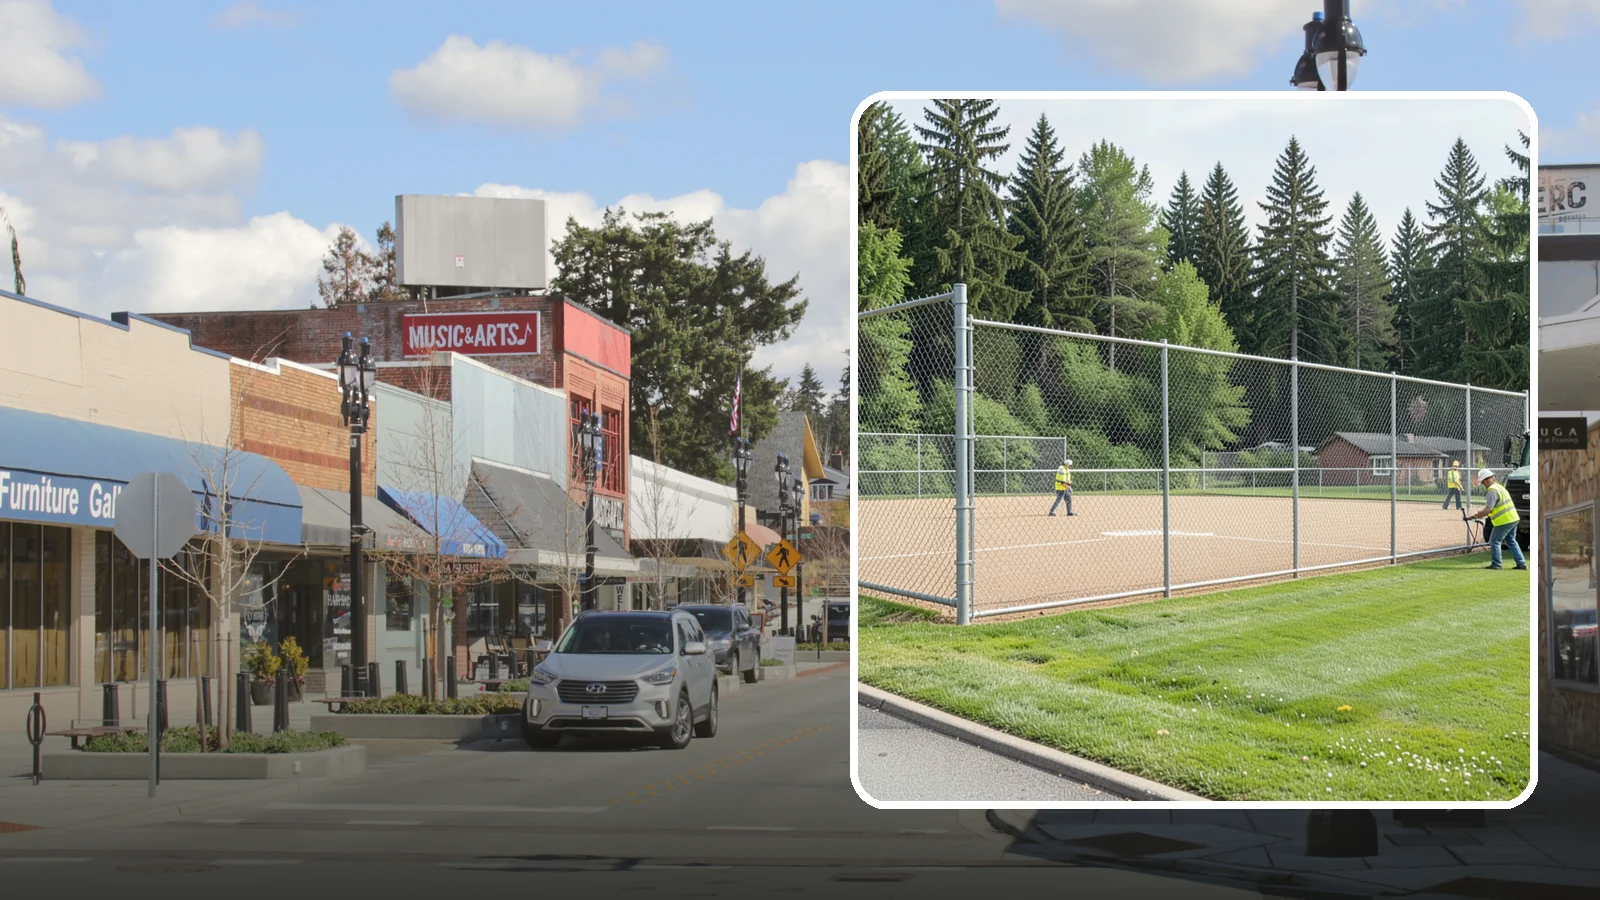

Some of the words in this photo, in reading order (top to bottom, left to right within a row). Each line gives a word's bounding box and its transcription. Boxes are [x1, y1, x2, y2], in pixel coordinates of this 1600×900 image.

[409, 323, 519, 348] MUSIC&ARTS
[1540, 427, 1577, 437] UGA
[0, 471, 79, 515] Furniture
[89, 482, 121, 519] Gal
[453, 563, 478, 574] SUSHI
